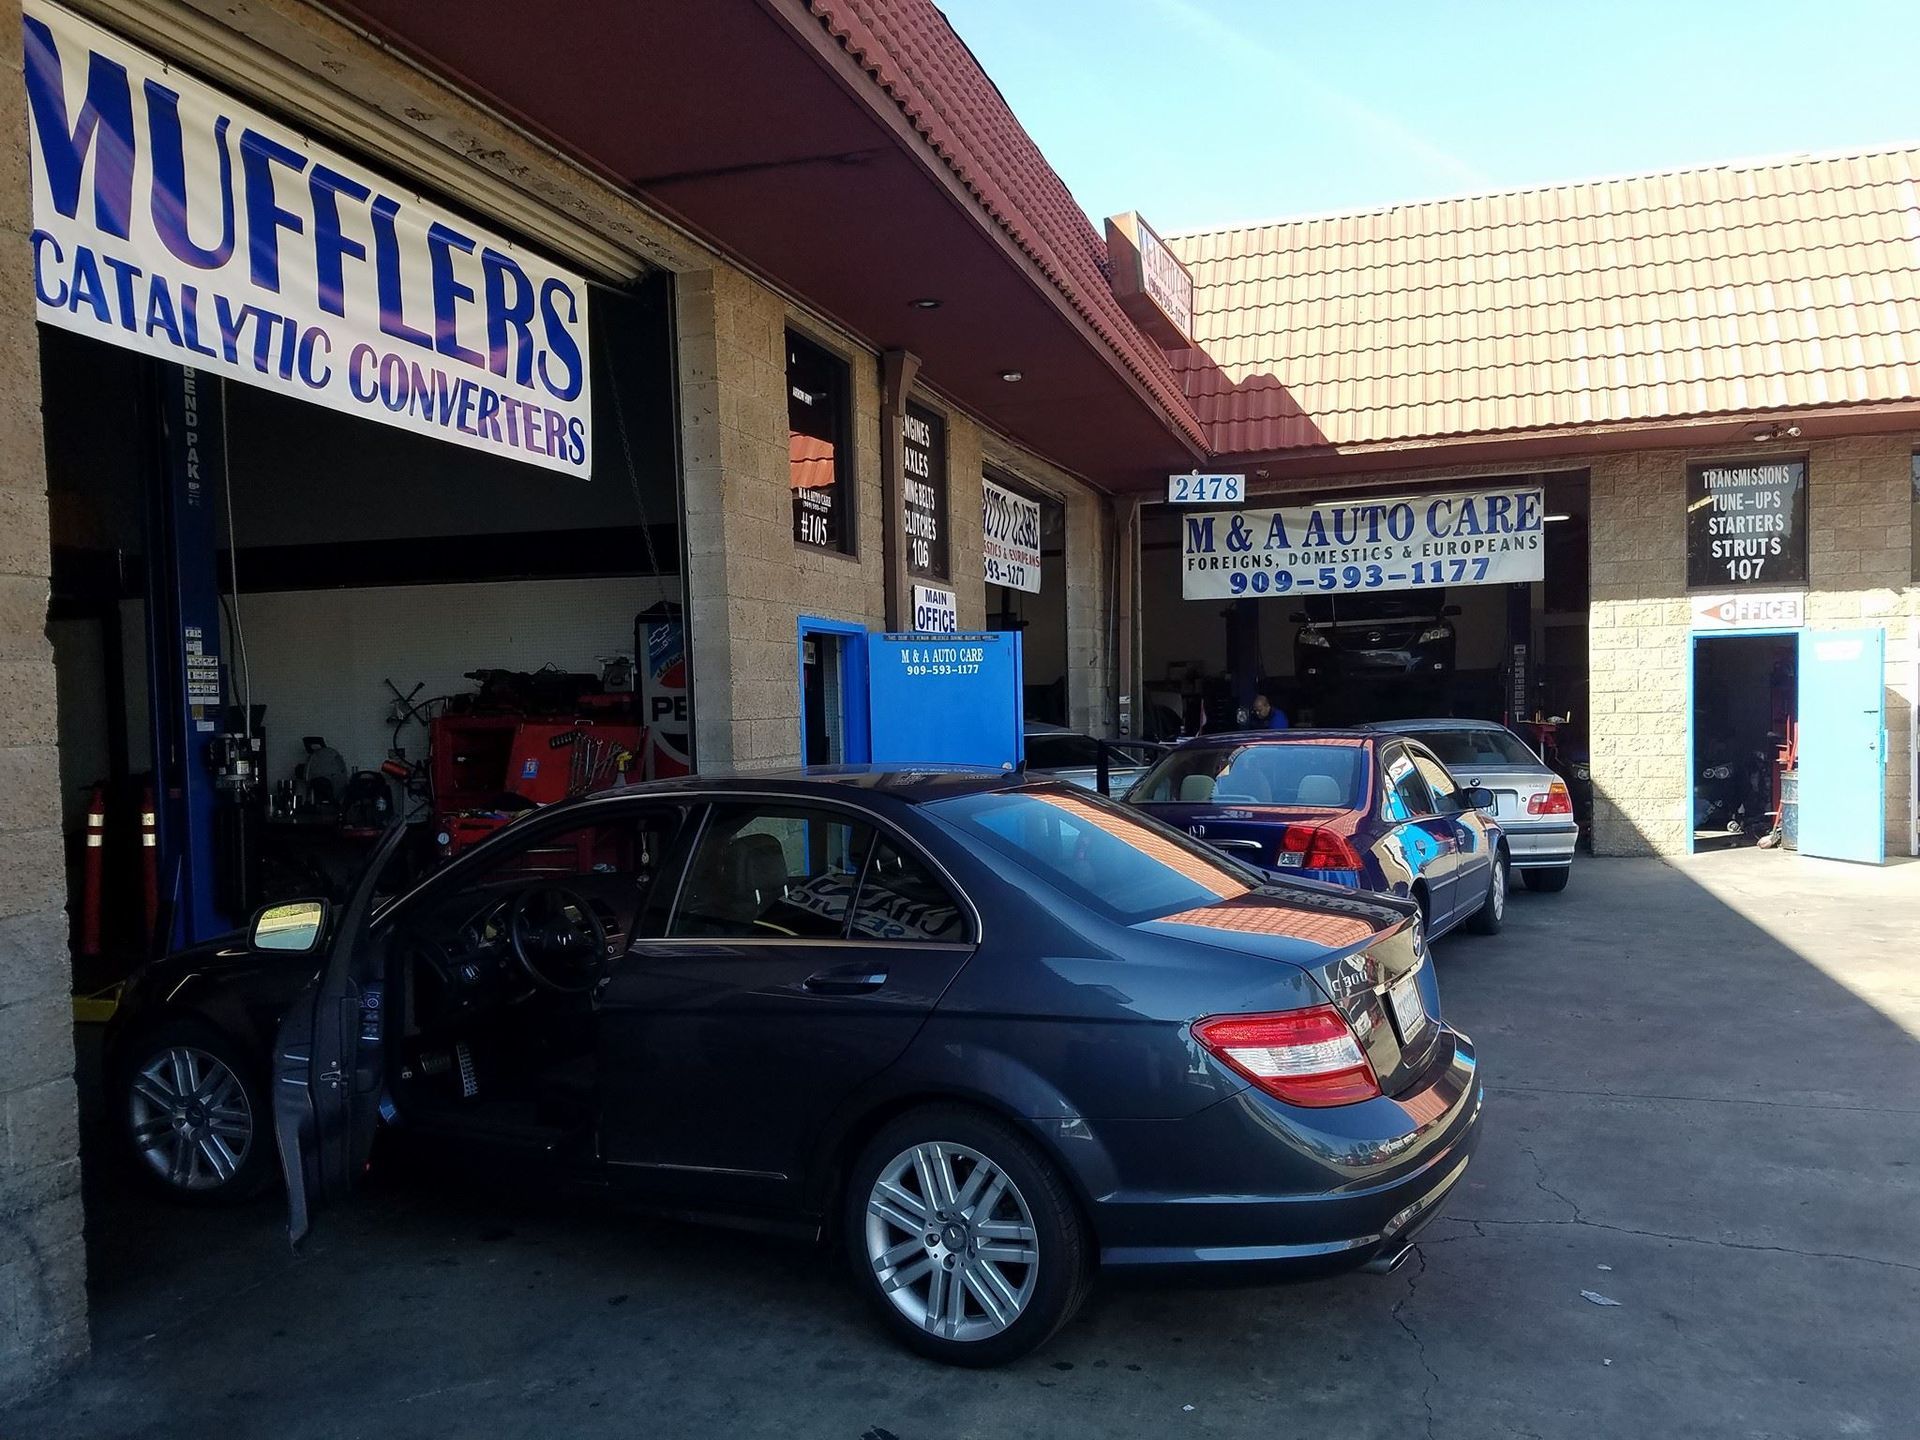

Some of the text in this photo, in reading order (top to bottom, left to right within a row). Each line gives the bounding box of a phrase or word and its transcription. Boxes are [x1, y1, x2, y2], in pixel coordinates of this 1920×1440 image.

[24, 13, 583, 402] MUFFLERS
[33, 229, 584, 466] CATALYTIC CONVERTERS
[902, 413, 930, 448] NGINES
[186, 431, 200, 480] PAK
[904, 446, 929, 478] AXLES
[1175, 477, 1239, 501] 2478
[1702, 466, 1790, 489] TRANSMISSIONS
[1712, 491, 1781, 512] TUNE-UPS
[801, 511, 827, 546] #105
[904, 509, 937, 541] CLUTCHES
[1186, 492, 1542, 554] M & A AUTO CARE
[1708, 514, 1784, 535] STARTERS
[912, 538, 929, 568] 106
[1187, 535, 1539, 571] FOREIGNS, DOMESTICS & EUROPEANS
[1712, 537, 1782, 558] STRUTS
[1229, 557, 1492, 595] 909-593-1177
[1726, 558, 1765, 580] 107
[925, 589, 947, 606] MAIN
[1719, 600, 1797, 621] OFFICE
[917, 605, 955, 633] OFFICE
[901, 648, 984, 663] M & A AUTO CARE
[907, 664, 979, 675] 909-593-1177
